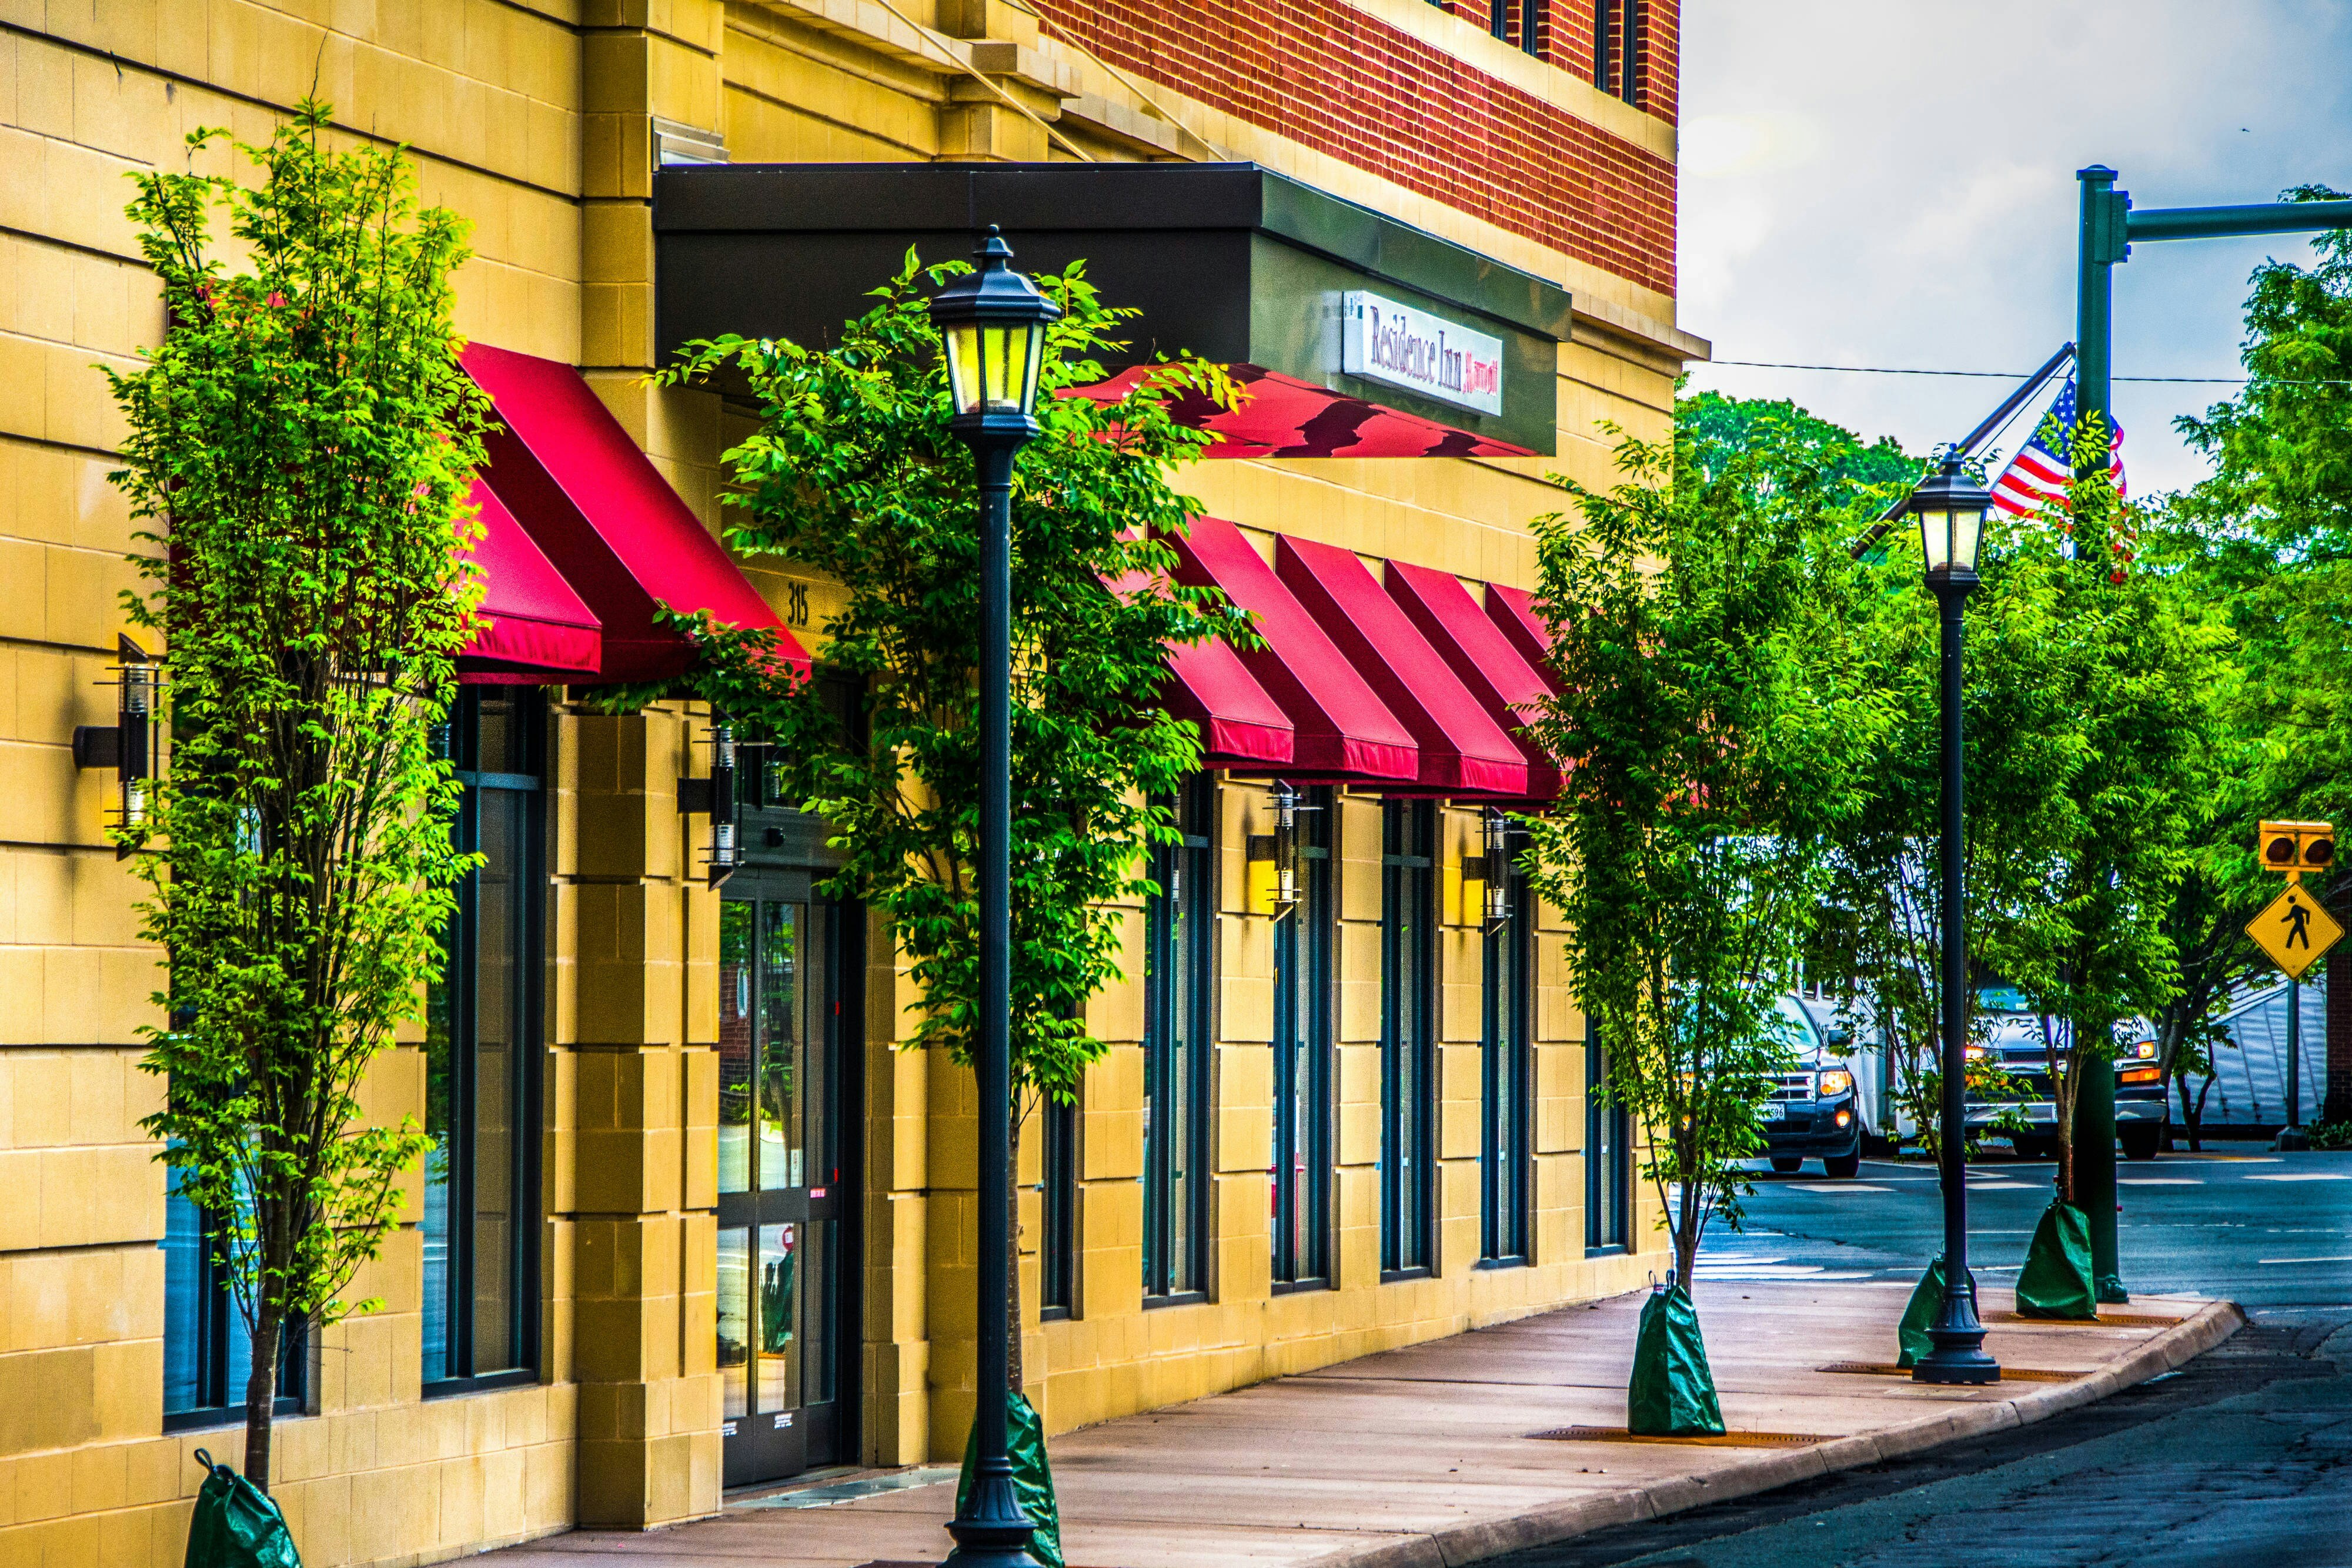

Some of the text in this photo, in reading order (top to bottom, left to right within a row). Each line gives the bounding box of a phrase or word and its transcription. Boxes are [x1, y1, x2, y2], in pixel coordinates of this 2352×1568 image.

[1371, 306, 1435, 385] Residence
[1439, 330, 1461, 392] Inn
[788, 581, 808, 626] 315
